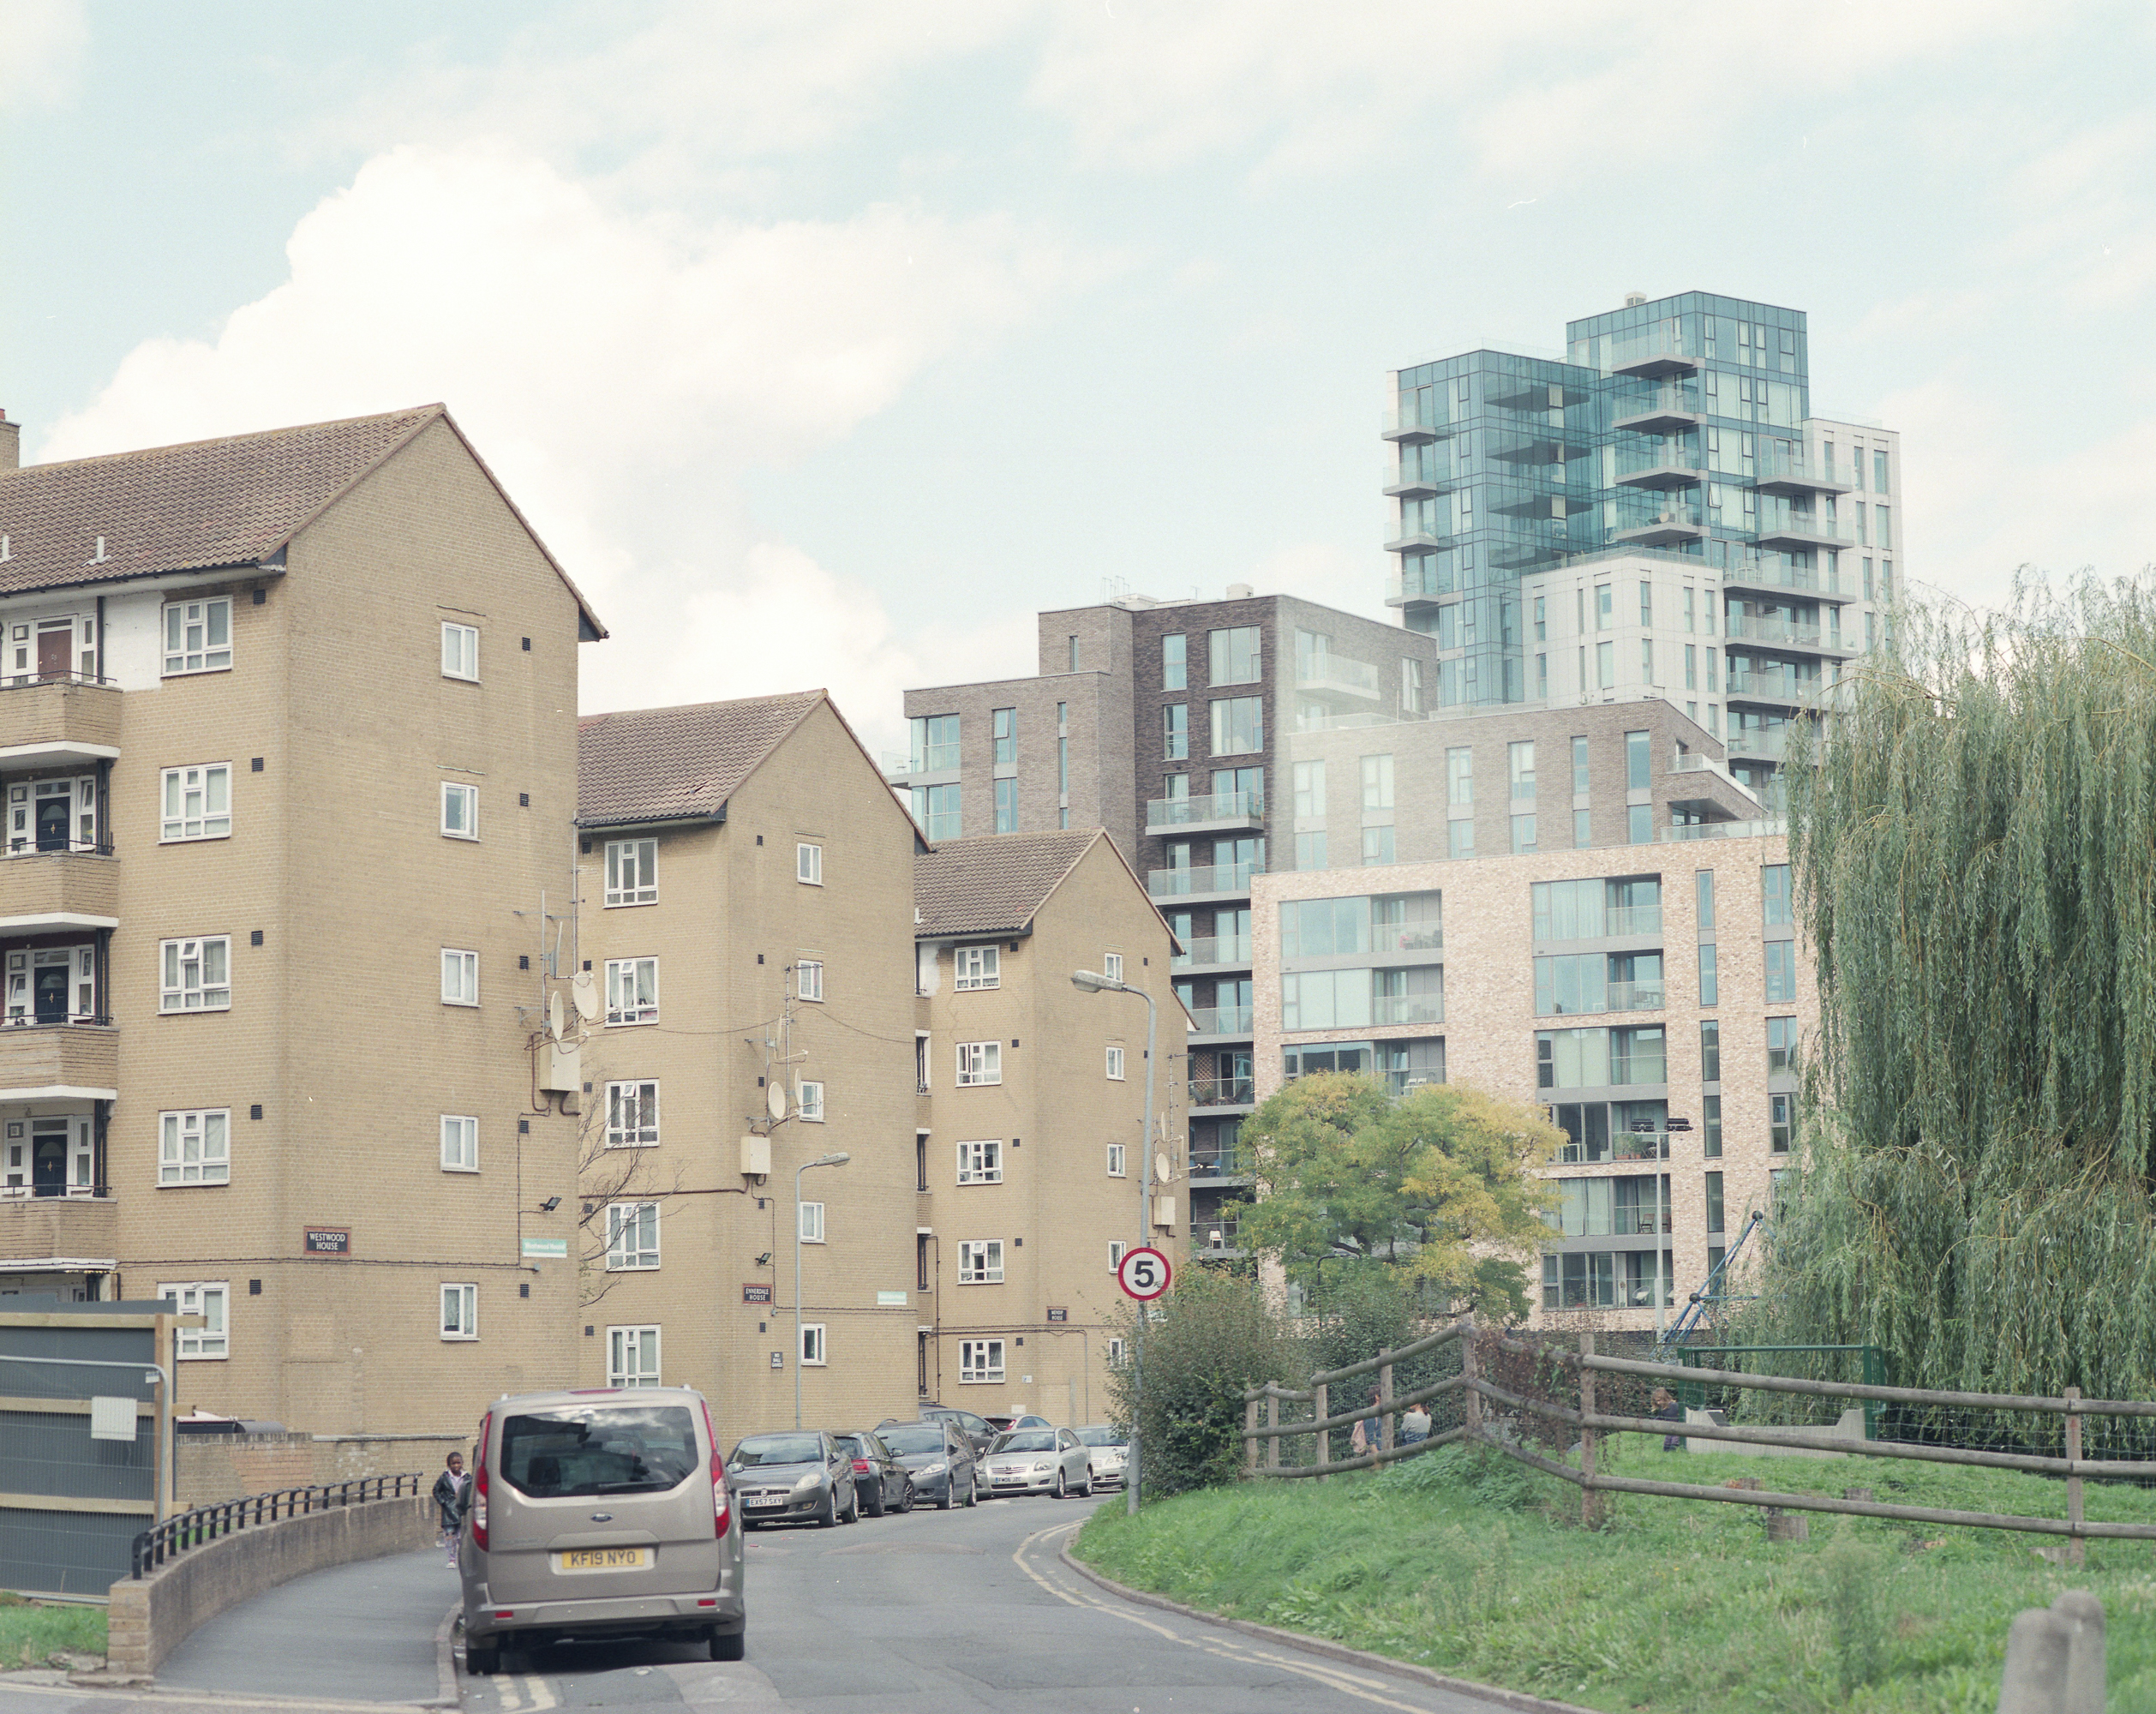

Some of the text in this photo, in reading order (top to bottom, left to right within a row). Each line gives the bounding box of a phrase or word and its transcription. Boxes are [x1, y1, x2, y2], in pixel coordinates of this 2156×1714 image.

[309, 1232, 345, 1242] WESTWOOD
[316, 1242, 338, 1250] HOUSE
[1134, 1261, 1154, 1288] 5
[570, 1550, 636, 1566] KF19 NYO
